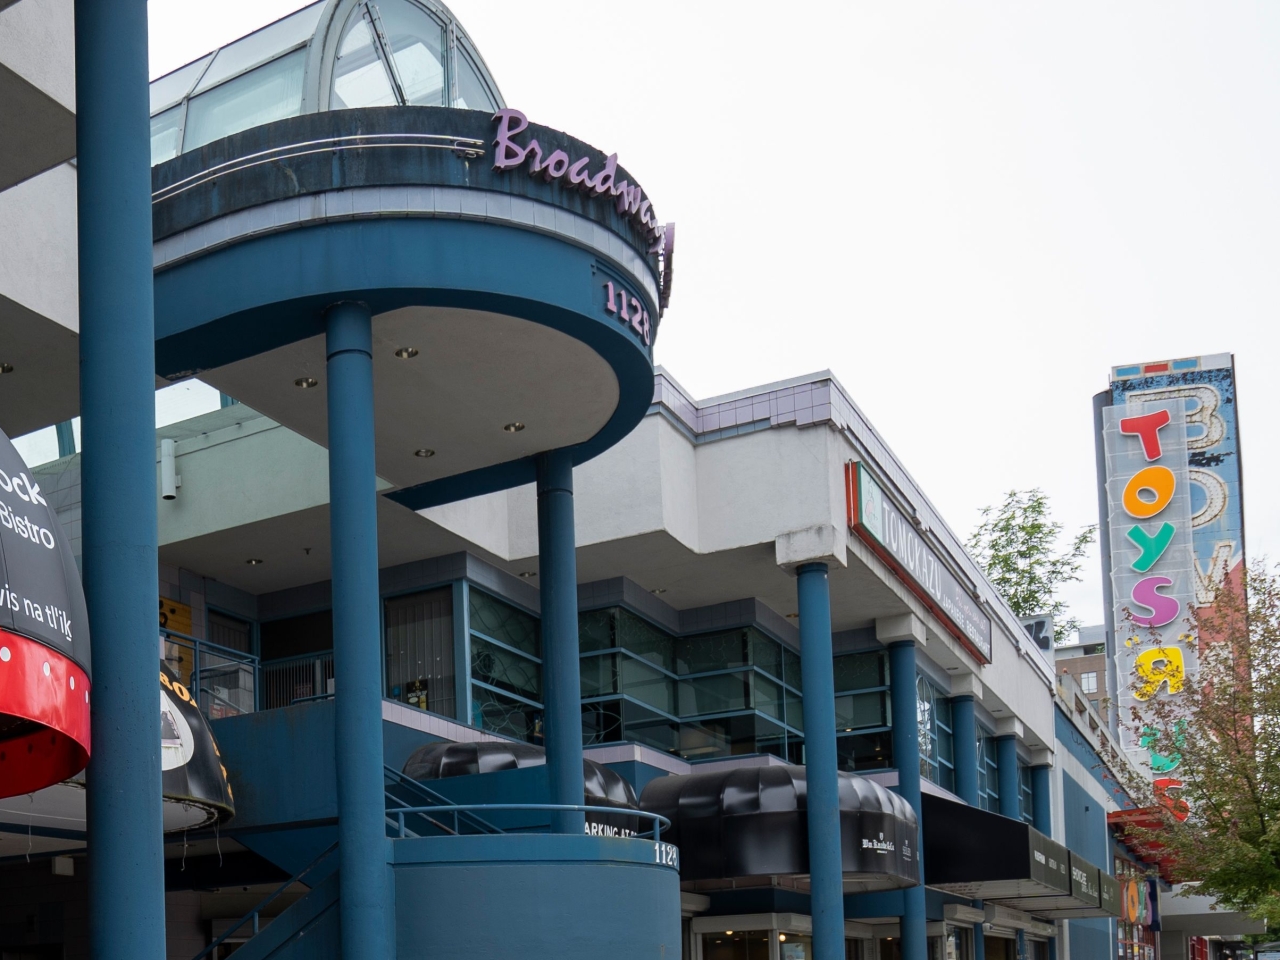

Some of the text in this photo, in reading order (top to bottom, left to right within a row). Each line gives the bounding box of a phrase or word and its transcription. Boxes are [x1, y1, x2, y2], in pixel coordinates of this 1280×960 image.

[604, 282, 651, 346] 1128
[1119, 408, 1180, 628] TOYS
[883, 501, 942, 600] TOMOKAZU
[23, 597, 43, 623] na
[655, 842, 678, 867] 1128
